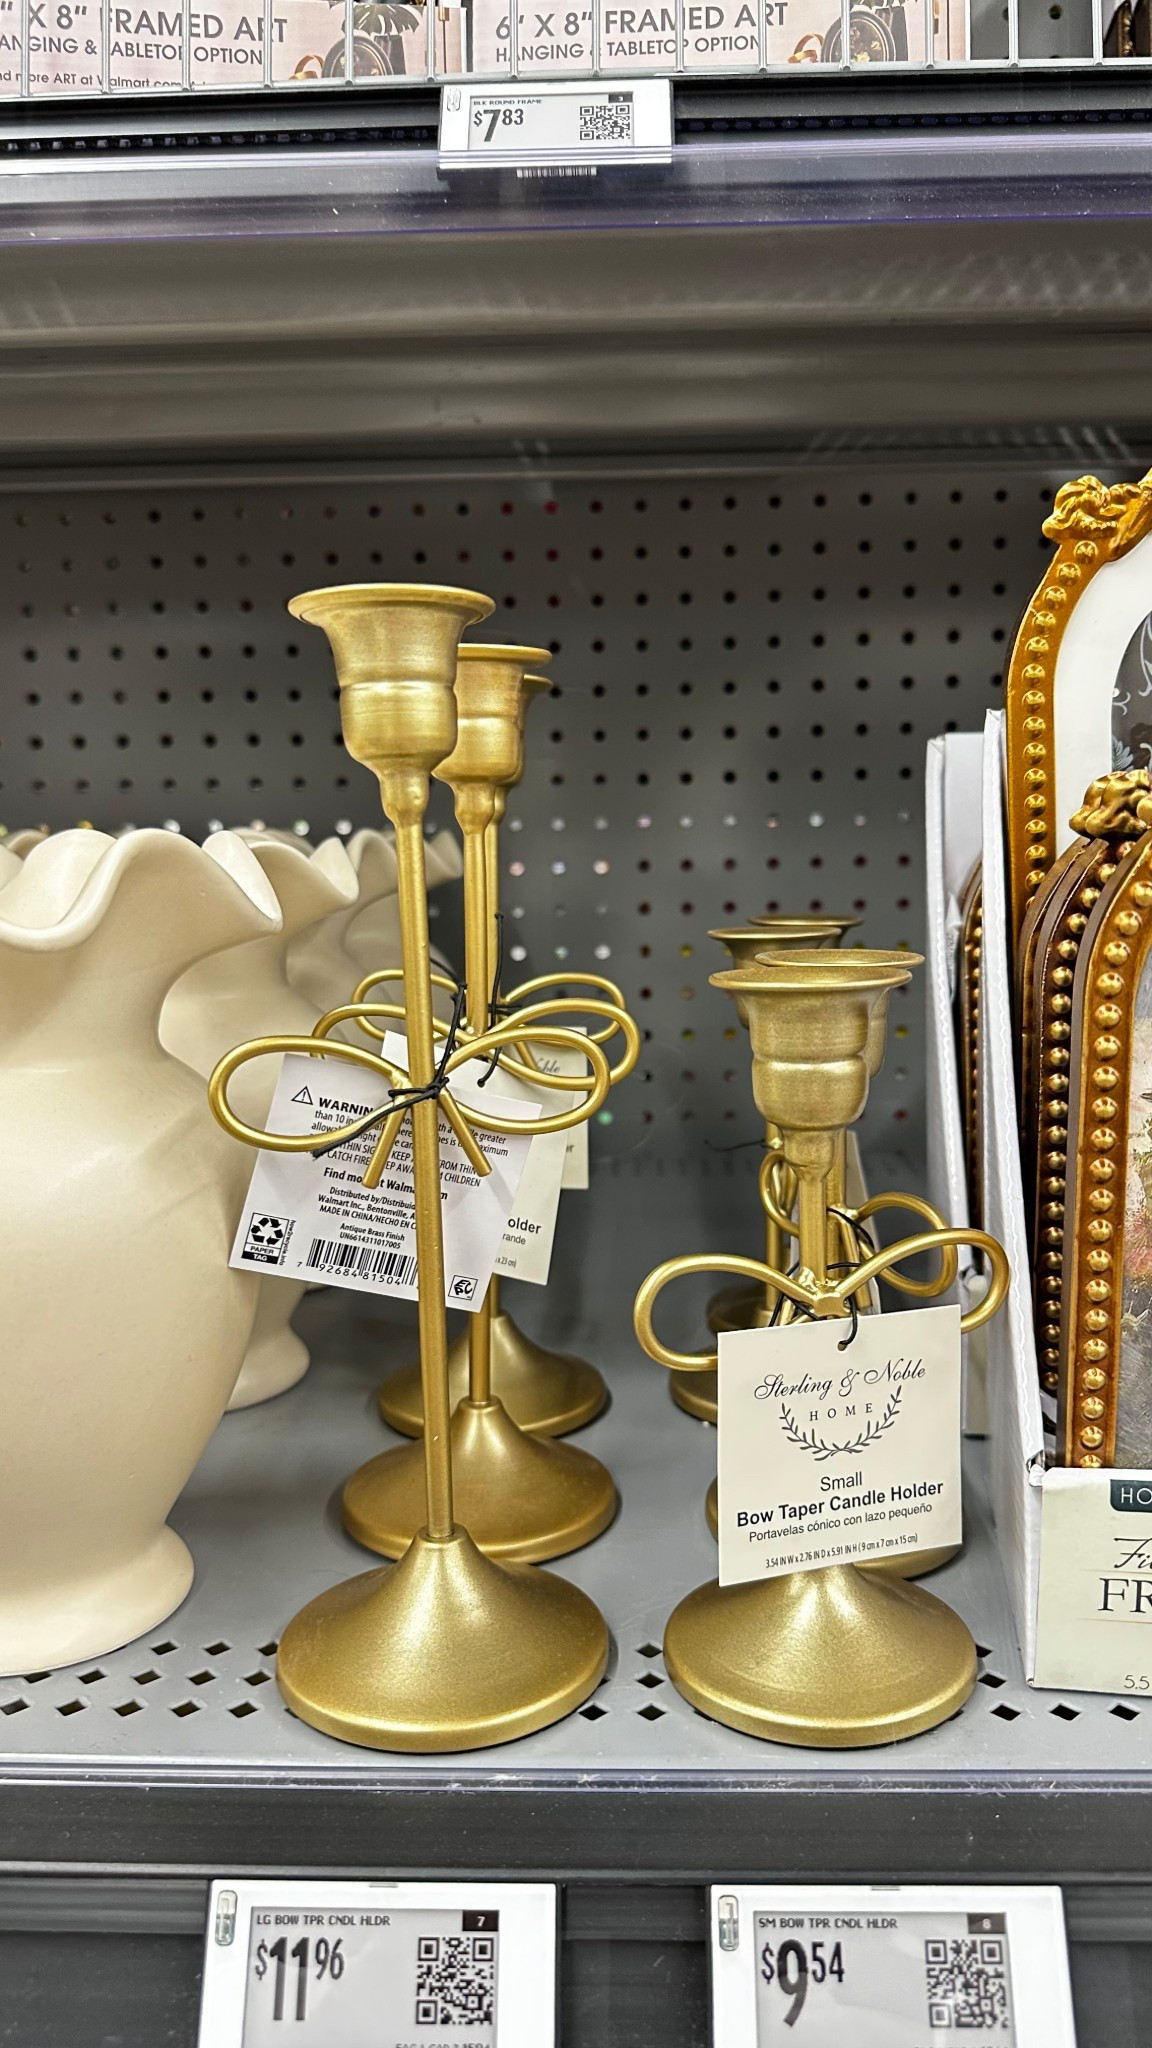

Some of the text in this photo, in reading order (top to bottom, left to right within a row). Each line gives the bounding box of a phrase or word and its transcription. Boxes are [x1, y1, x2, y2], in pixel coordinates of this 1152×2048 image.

[57, 5, 87, 30] 8"
[534, 13, 555, 38] X
[564, 11, 592, 36] 8"
[84, 39, 98, 55] &
[110, 41, 183, 61] ABLETO
[194, 46, 262, 65] OPTION
[54, 73, 76, 84] ART
[81, 75, 93, 86] at
[319, 1097, 374, 1116] WARNIN
[479, 1132, 506, 1144] greater
[314, 1110, 333, 1121] than
[335, 1113, 345, 1124] 10
[480, 1144, 509, 1157] aximum
[391, 1150, 411, 1161] KEEP
[323, 1166, 346, 1181] Find
[347, 1174, 362, 1184] mo
[396, 1163, 414, 1174] AWA
[444, 1172, 481, 1187] CHILDREN
[329, 1186, 370, 1201] Distributed
[318, 1194, 349, 1209] Walmart
[366, 1203, 409, 1219] Bentonville,
[319, 1204, 341, 1216] MADE
[342, 1209, 350, 1218] IN
[351, 1210, 400, 1227] CHINA/HECHO
[400, 1219, 410, 1229] EN
[340, 1222, 405, 1241] Antique Brass Finish
[508, 1217, 542, 1234] older
[250, 1245, 274, 1255] PAPER
[502, 1233, 526, 1245] rande
[319, 1263, 358, 1278] 92684
[362, 1272, 401, 1286] 81504
[754, 1357, 926, 1400] Sterling & Noble
[809, 1402, 873, 1422] HOME
[820, 1471, 863, 1492] Small
[737, 1482, 944, 1527] Bow Taper Candle Holder
[749, 1502, 932, 1542] Portavelas cónico con lazo pequeño
[765, 1557, 779, 1569] 3.54
[780, 1555, 786, 1565] IN
[800, 1551, 813, 1562] 2.76
[813, 1549, 820, 1559] IN
[821, 1549, 826, 1558] D
[831, 1545, 844, 1556] 5.91
[844, 1544, 852, 1554] IN
[852, 1543, 857, 1552] H
[880, 1538, 885, 1547] 7
[900, 1534, 907, 1544] 15
[257, 1914, 486, 1928] LG BOW TPR CNDL HLDR 7
[759, 1917, 992, 1930] SM BOW TPR CNDL HLDR 8
